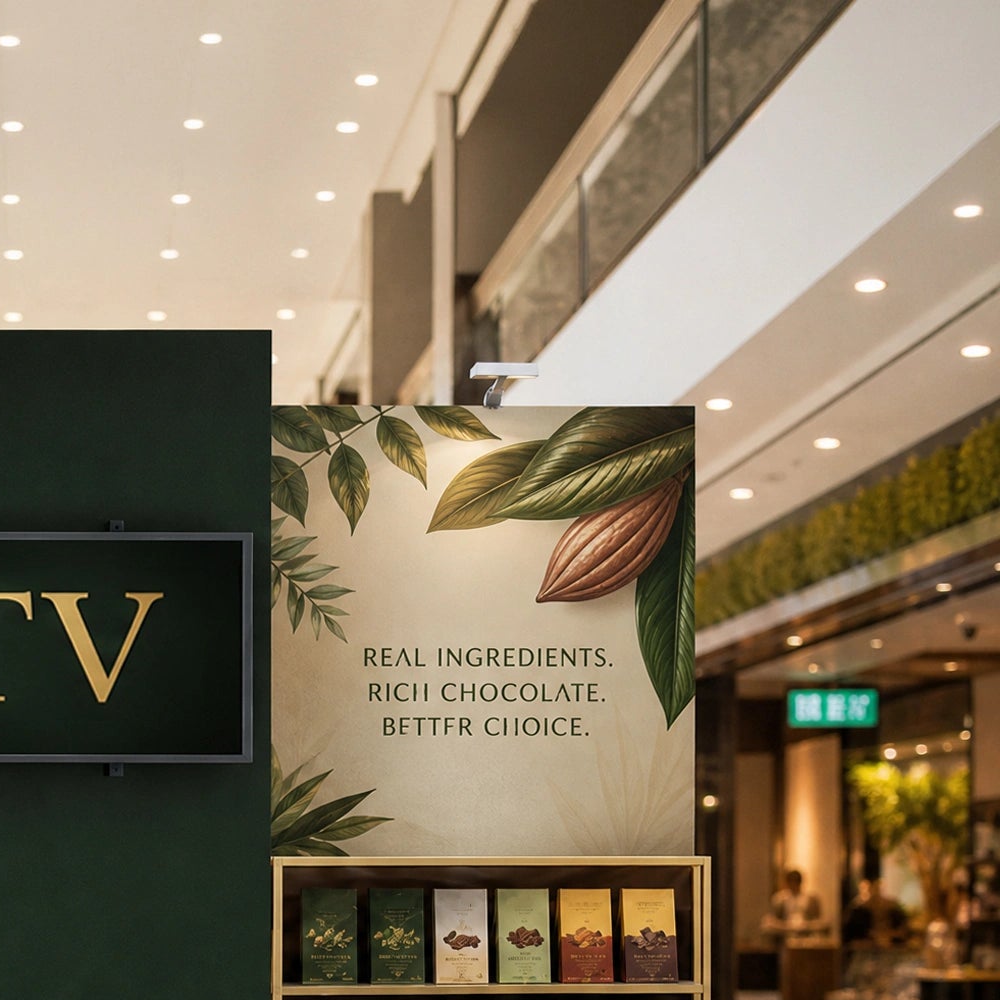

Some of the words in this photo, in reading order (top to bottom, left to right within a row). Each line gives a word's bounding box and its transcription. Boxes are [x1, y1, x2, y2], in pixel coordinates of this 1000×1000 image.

[364, 648, 425, 666] REAL
[439, 648, 612, 667] INGREDIENTS.
[441, 683, 605, 702] CHOCOLATE.
